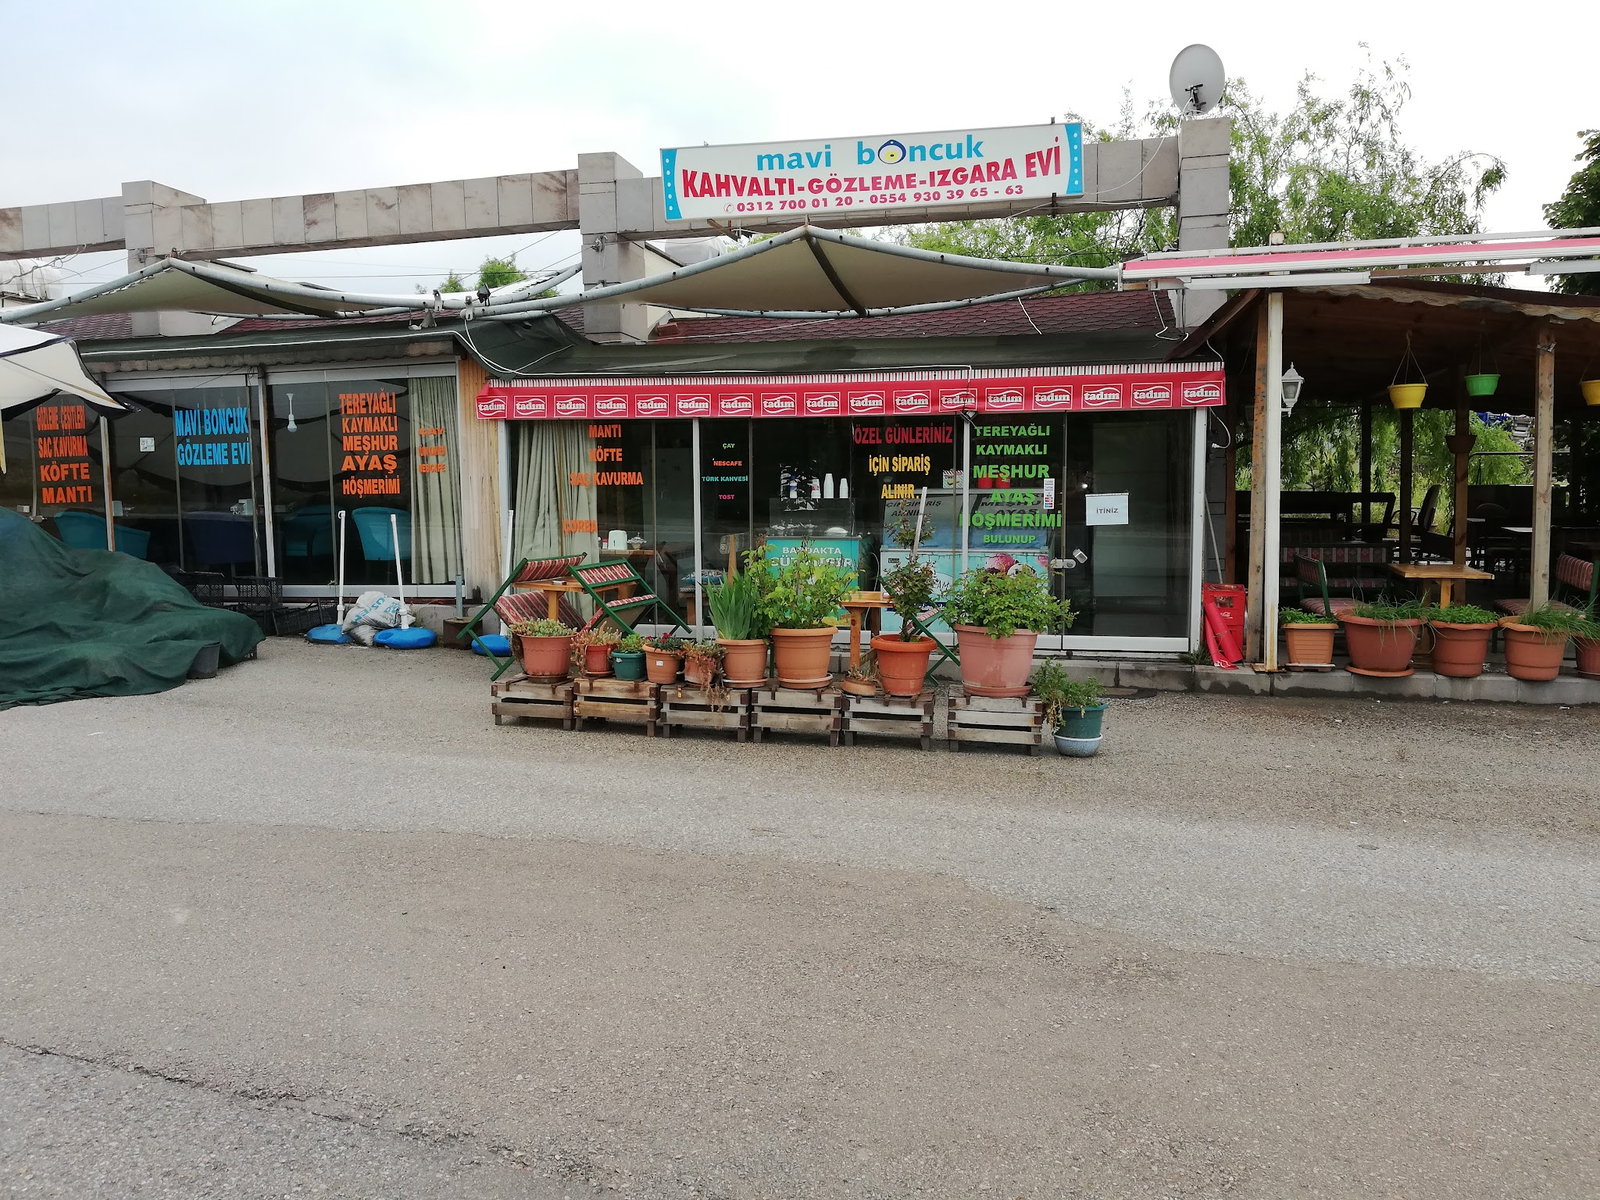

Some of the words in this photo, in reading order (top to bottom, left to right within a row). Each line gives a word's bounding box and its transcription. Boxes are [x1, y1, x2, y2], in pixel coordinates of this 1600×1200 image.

[757, 144, 831, 171] mavi
[1025, 136, 1061, 178] EVİ
[737, 201, 774, 212] 0312
[779, 199, 806, 210] 700
[811, 197, 828, 208] 01
[835, 196, 853, 206] 20
[869, 192, 906, 204] 0554
[913, 190, 941, 201] 930
[946, 189, 964, 199] 39
[969, 187, 988, 197] 65
[1005, 184, 1023, 195] 63
[339, 387, 396, 414] TEREYAĞLI
[175, 402, 202, 437] MAVİ
[203, 407, 249, 435] BONCUK
[342, 416, 398, 433] KAYMAKLI
[976, 423, 1051, 437] TEREYAĞLI
[588, 424, 622, 438] MANTI
[854, 424, 882, 444] ÖZEL
[885, 422, 953, 444] GÜNLERİNİZ
[54, 435, 89, 457] KAVURMA
[177, 438, 229, 466] GÖZLEME
[231, 436, 251, 465] EVİ
[343, 434, 398, 455] MEŞHUR
[588, 445, 623, 462] KÖFTE
[976, 444, 1048, 455] KAYMAKLI
[40, 461, 90, 482] KÖFTE
[341, 454, 398, 474] AYAŞ
[869, 454, 889, 476] İÇİN
[892, 453, 931, 475] SİPARİŞ
[973, 464, 1050, 482] MEŞHUR
[342, 475, 400, 499] HÖŞMERİMİ
[592, 471, 644, 485] KAVURMA
[42, 485, 93, 504] MANTI
[989, 489, 1038, 507] AYAŞ
[983, 534, 1036, 544] BULUNUP
